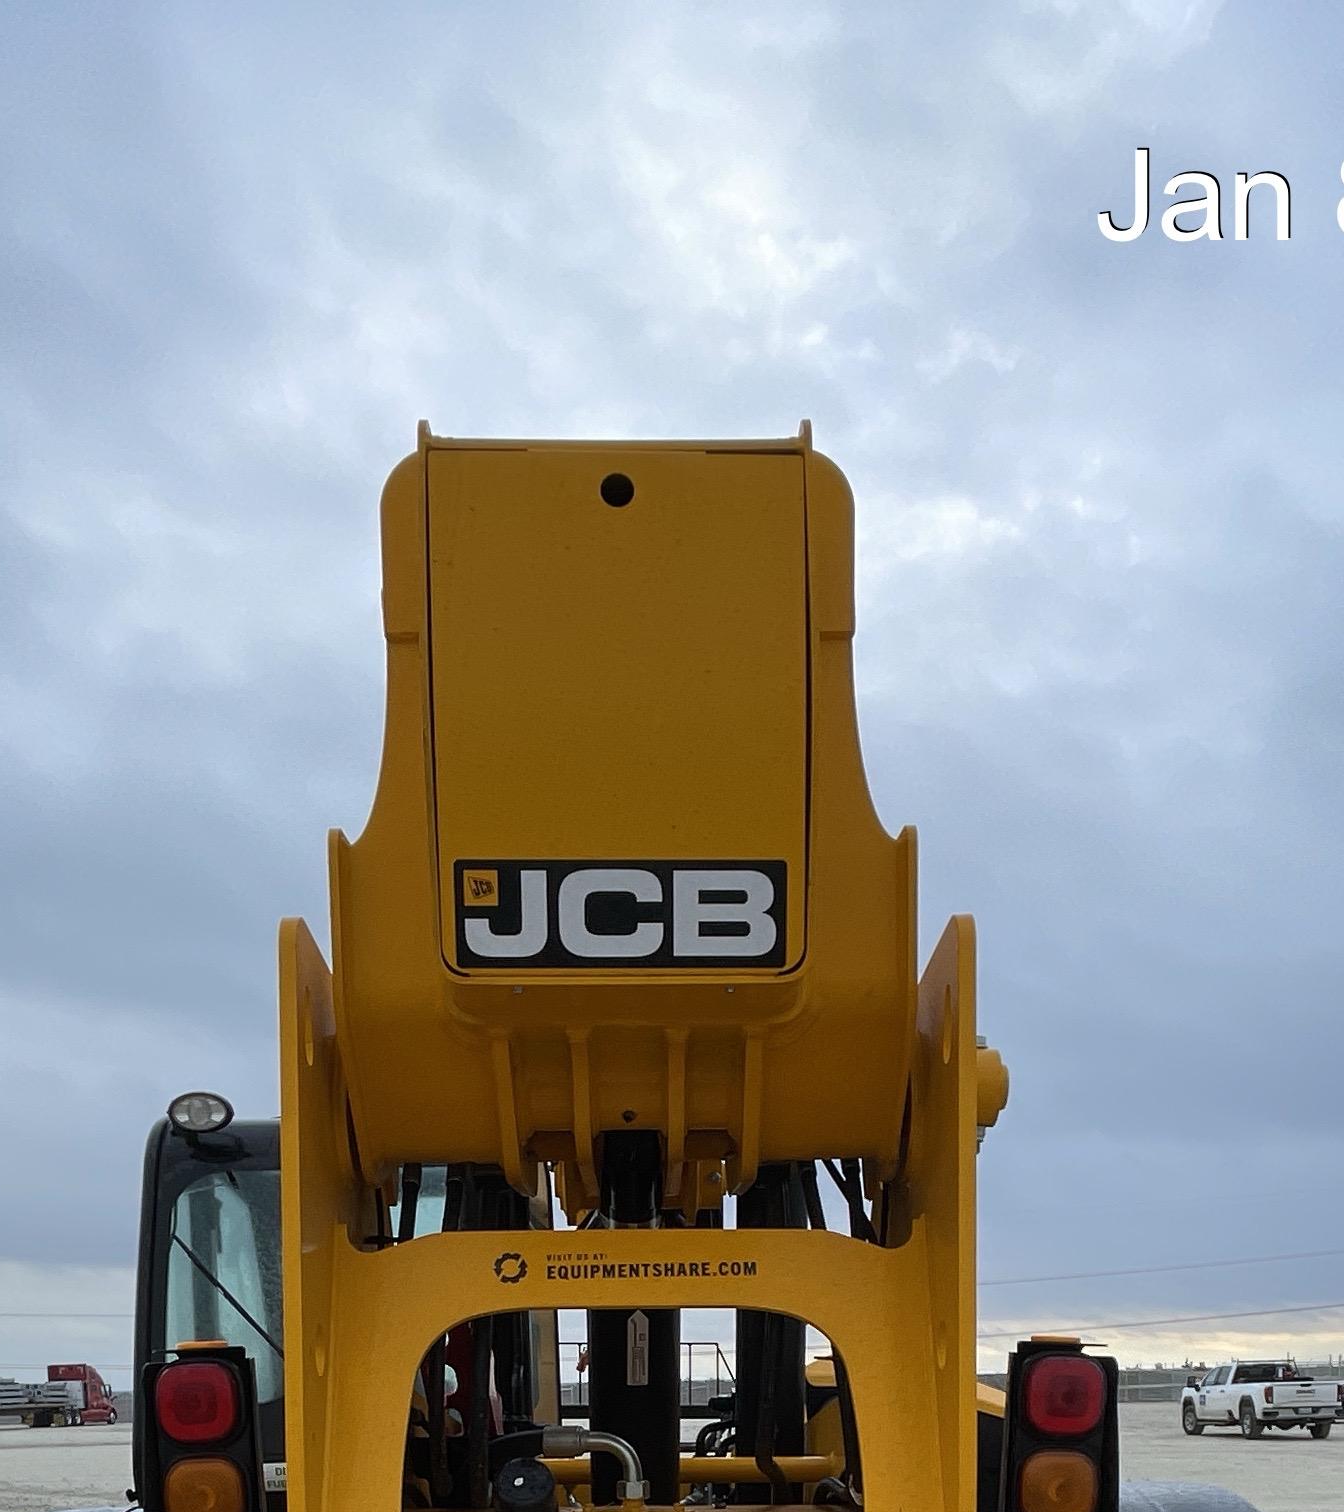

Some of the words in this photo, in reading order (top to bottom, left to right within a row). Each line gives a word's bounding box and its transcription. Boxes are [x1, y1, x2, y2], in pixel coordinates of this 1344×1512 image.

[464, 869, 777, 958] JCB
[576, 1253, 589, 1261] US
[546, 1261, 757, 1281] EQUIPMENTSHARE.COM
